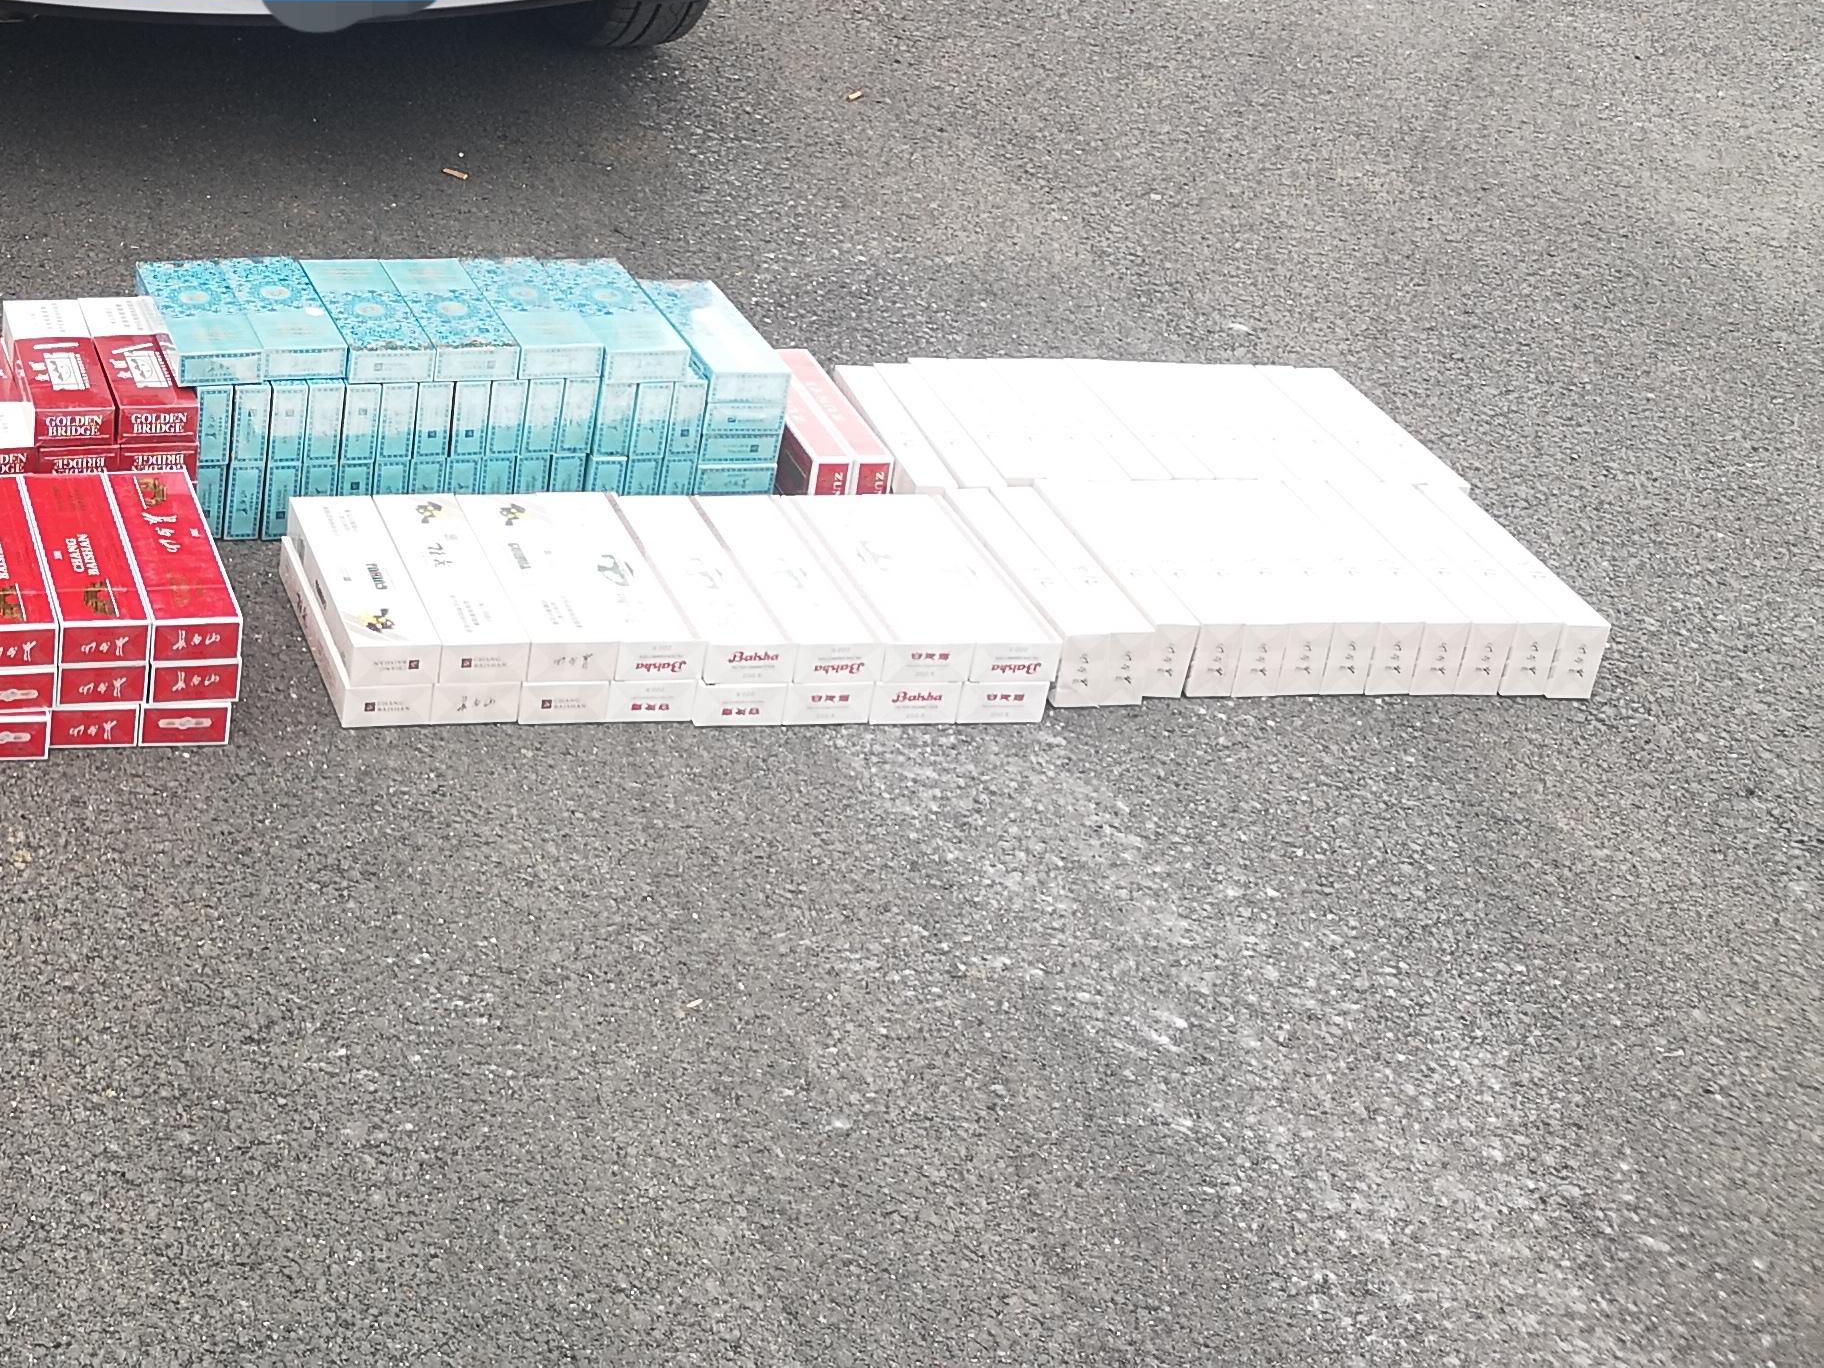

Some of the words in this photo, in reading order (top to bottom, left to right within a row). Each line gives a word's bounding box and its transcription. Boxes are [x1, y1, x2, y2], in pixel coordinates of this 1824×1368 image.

[46, 416, 102, 426] GOLDEN
[131, 413, 186, 424] GOLDEN
[48, 425, 100, 436] BRIDGE
[133, 422, 184, 434] BRIDGE
[54, 457, 105, 468] BRIDGE
[134, 455, 184, 466] BRIDGE
[66, 538, 84, 572] CHANG
[77, 534, 100, 576] BAISHAN
